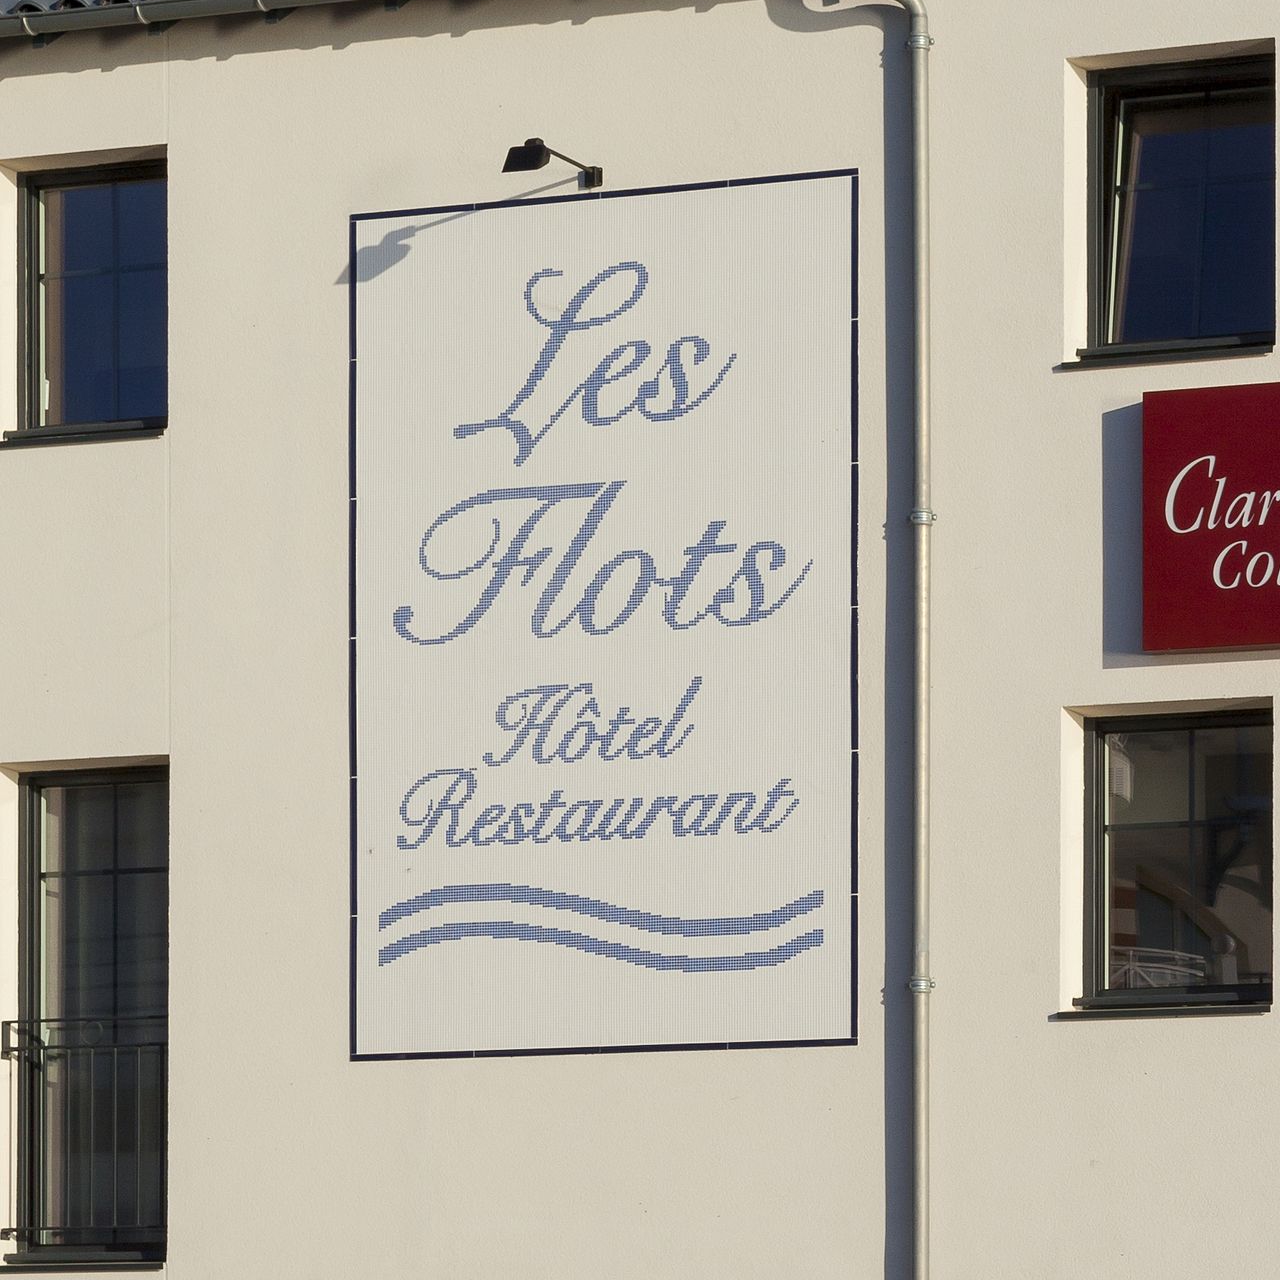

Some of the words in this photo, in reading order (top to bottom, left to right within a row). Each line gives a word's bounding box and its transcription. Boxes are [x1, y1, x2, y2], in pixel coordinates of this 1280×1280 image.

[453, 261, 737, 467] Les
[393, 480, 814, 647] Flots
[483, 676, 703, 768] Hôtel
[396, 766, 800, 851] Restaurant
